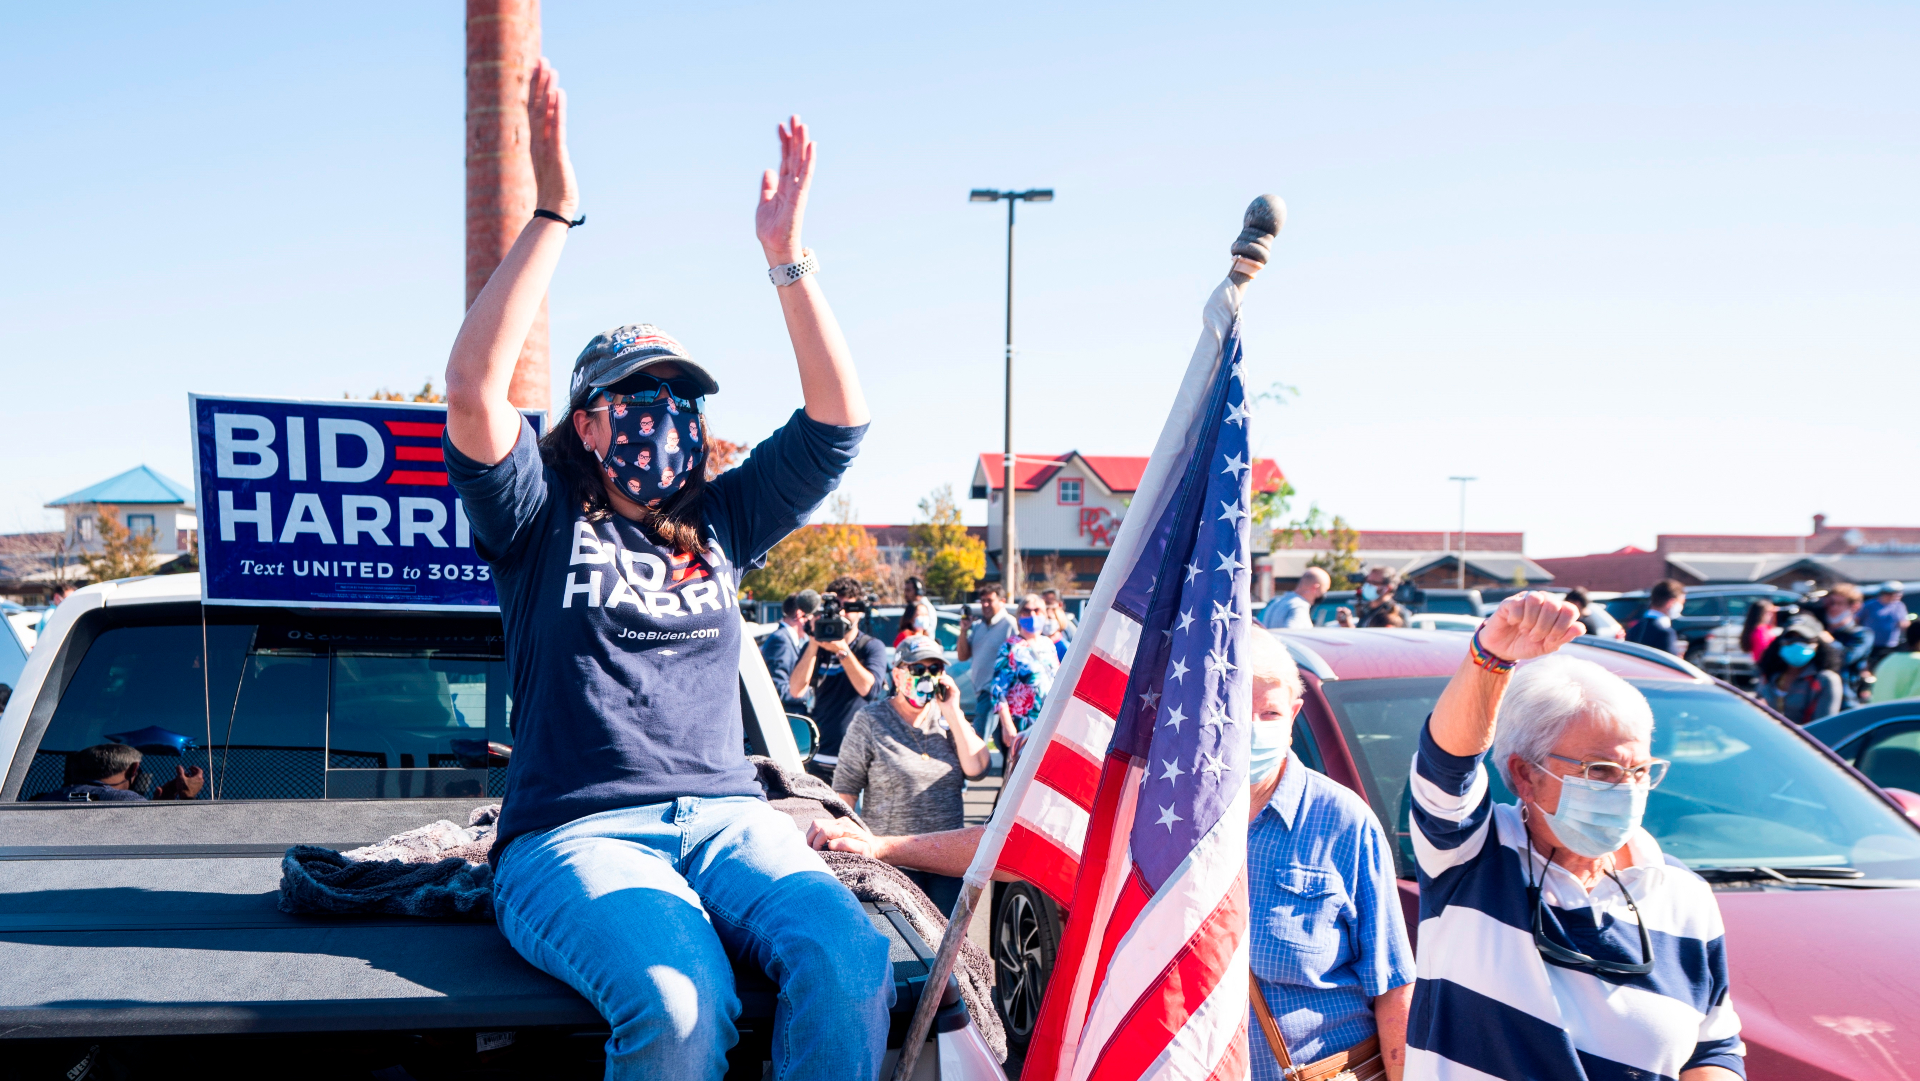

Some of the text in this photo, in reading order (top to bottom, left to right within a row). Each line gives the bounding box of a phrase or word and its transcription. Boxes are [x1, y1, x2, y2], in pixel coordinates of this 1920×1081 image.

[214, 413, 448, 486] BIDE
[217, 490, 471, 548] HARRI
[240, 559, 490, 581] Text UNITED to 3033
[617, 627, 720, 641] JoeBiden.com
